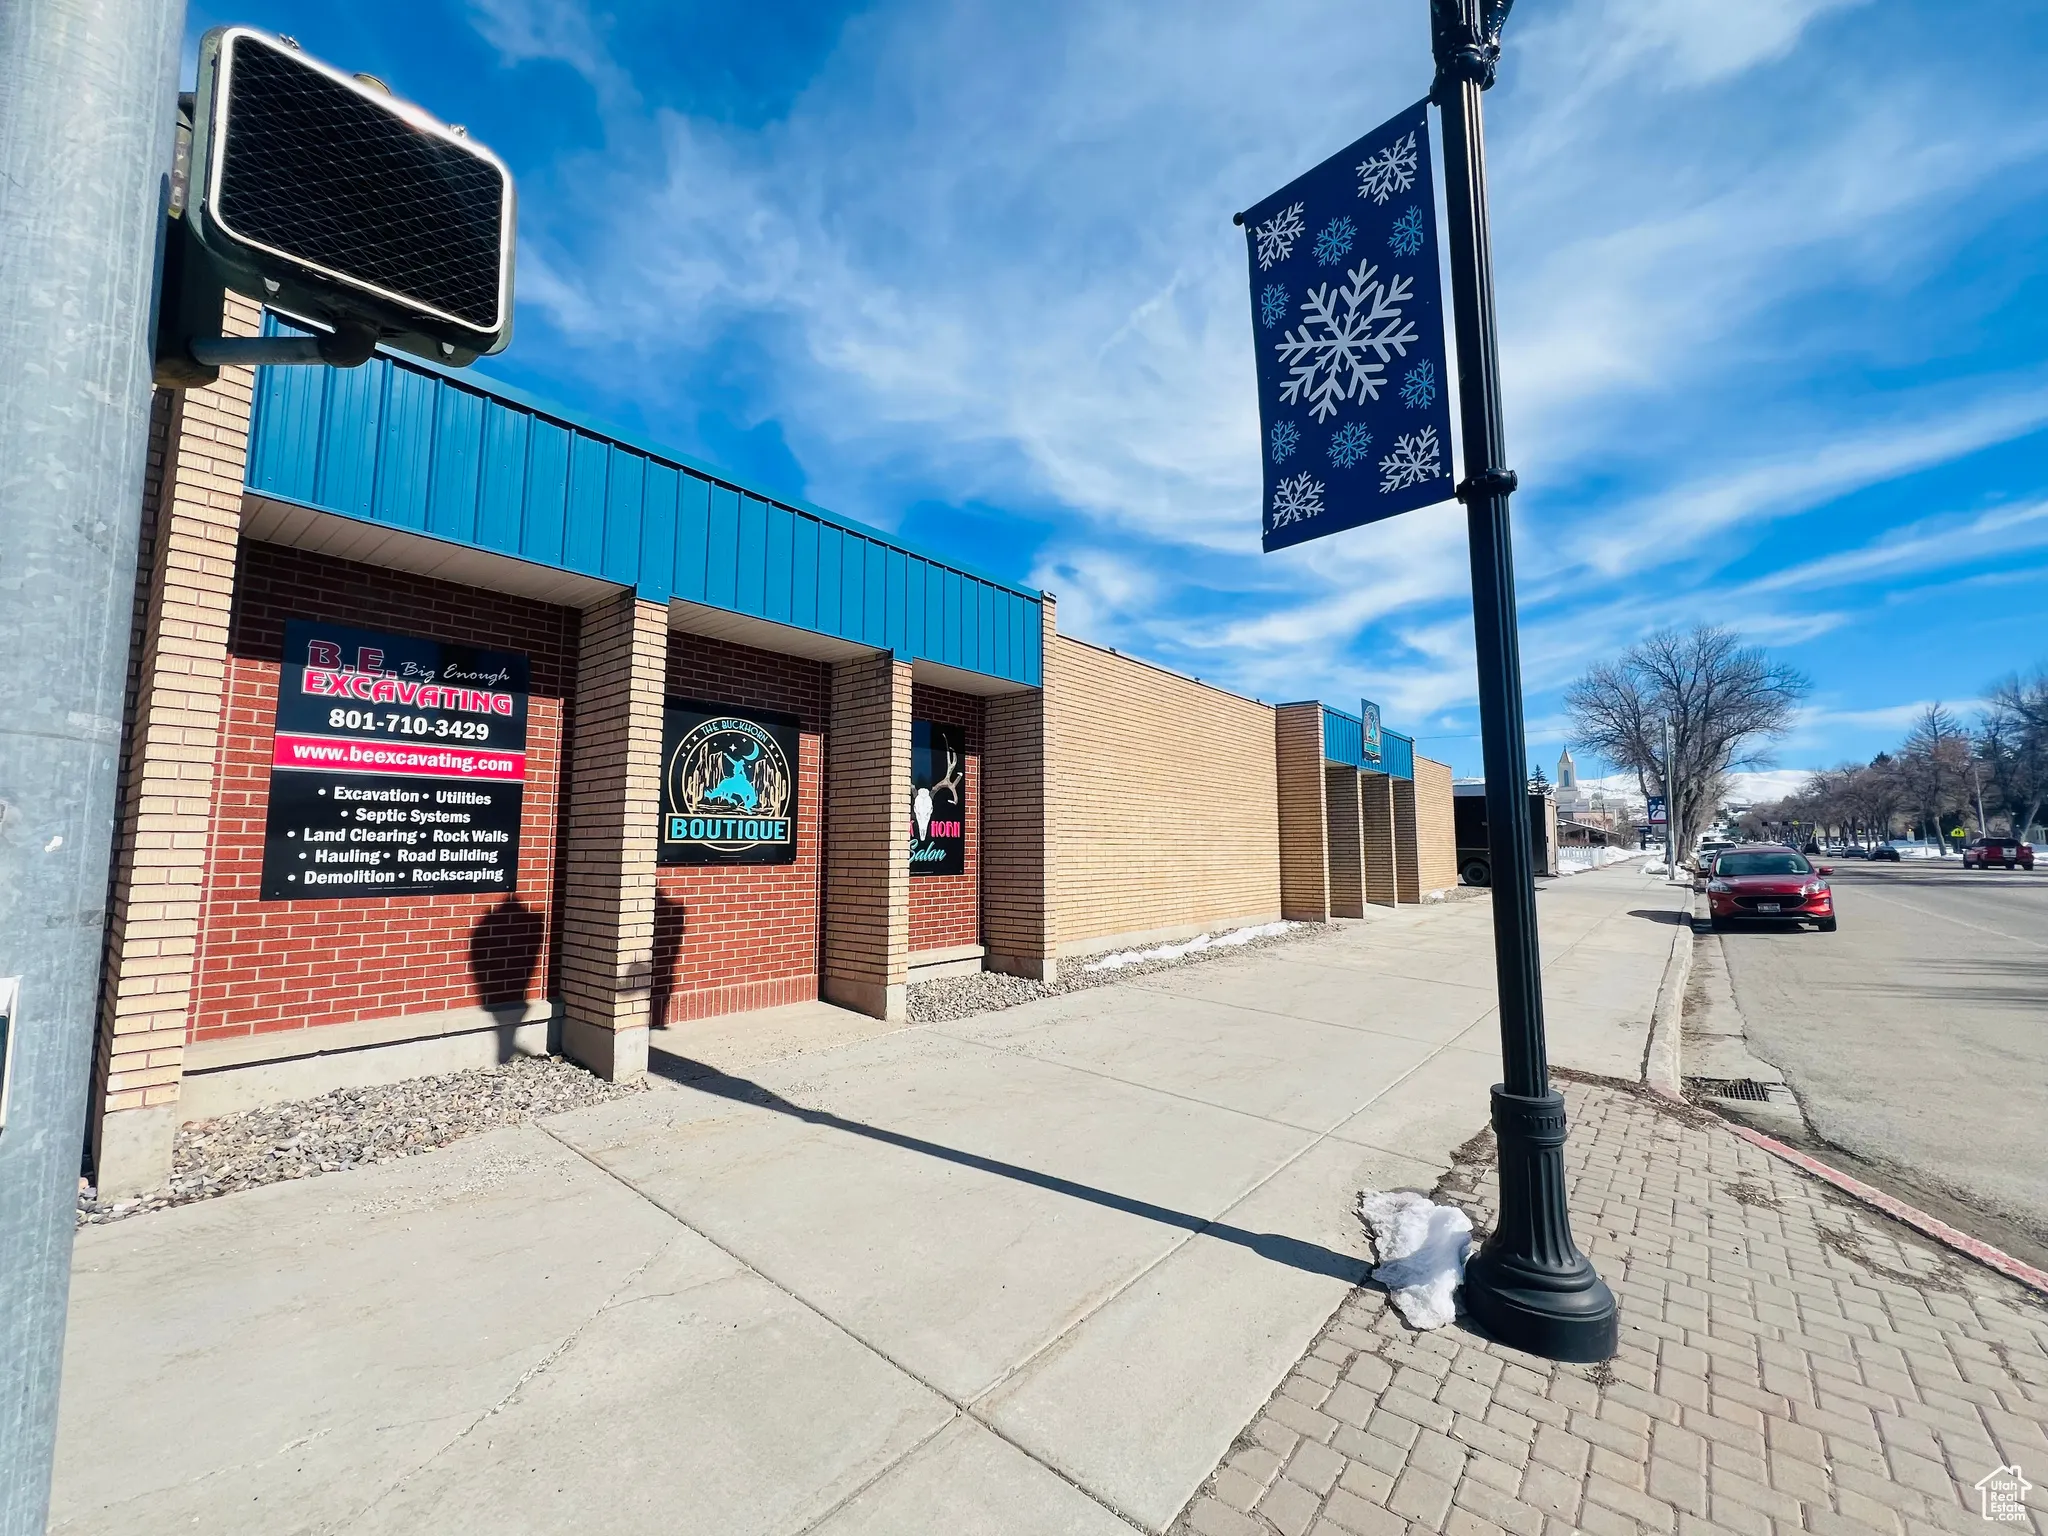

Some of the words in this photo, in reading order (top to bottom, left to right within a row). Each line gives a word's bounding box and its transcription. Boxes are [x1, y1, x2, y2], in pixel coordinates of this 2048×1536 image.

[308, 639, 398, 680] B.E.
[401, 661, 436, 684] Big
[443, 663, 510, 687] Enough
[301, 668, 513, 717] EXCAVATING
[328, 708, 489, 741] 801-710-3429
[700, 721, 719, 736] THE
[721, 720, 769, 743] BUCKHORN
[293, 745, 513, 772] www.beexcavating.com
[333, 786, 420, 803] Excavation
[436, 790, 492, 805] Utilities
[355, 807, 407, 825] Septic
[410, 809, 471, 825] Systems
[303, 827, 346, 842] Land
[350, 828, 418, 846] Clearing
[433, 829, 469, 843] Rock
[472, 830, 509, 843] Walls
[671, 817, 786, 841] BOUTIQUE
[931, 820, 960, 838] HORN
[315, 849, 381, 865] Hauling
[397, 850, 438, 863] Road
[439, 849, 498, 864] Building
[304, 870, 395, 885] Demolition
[412, 867, 504, 883] Rockscaping
